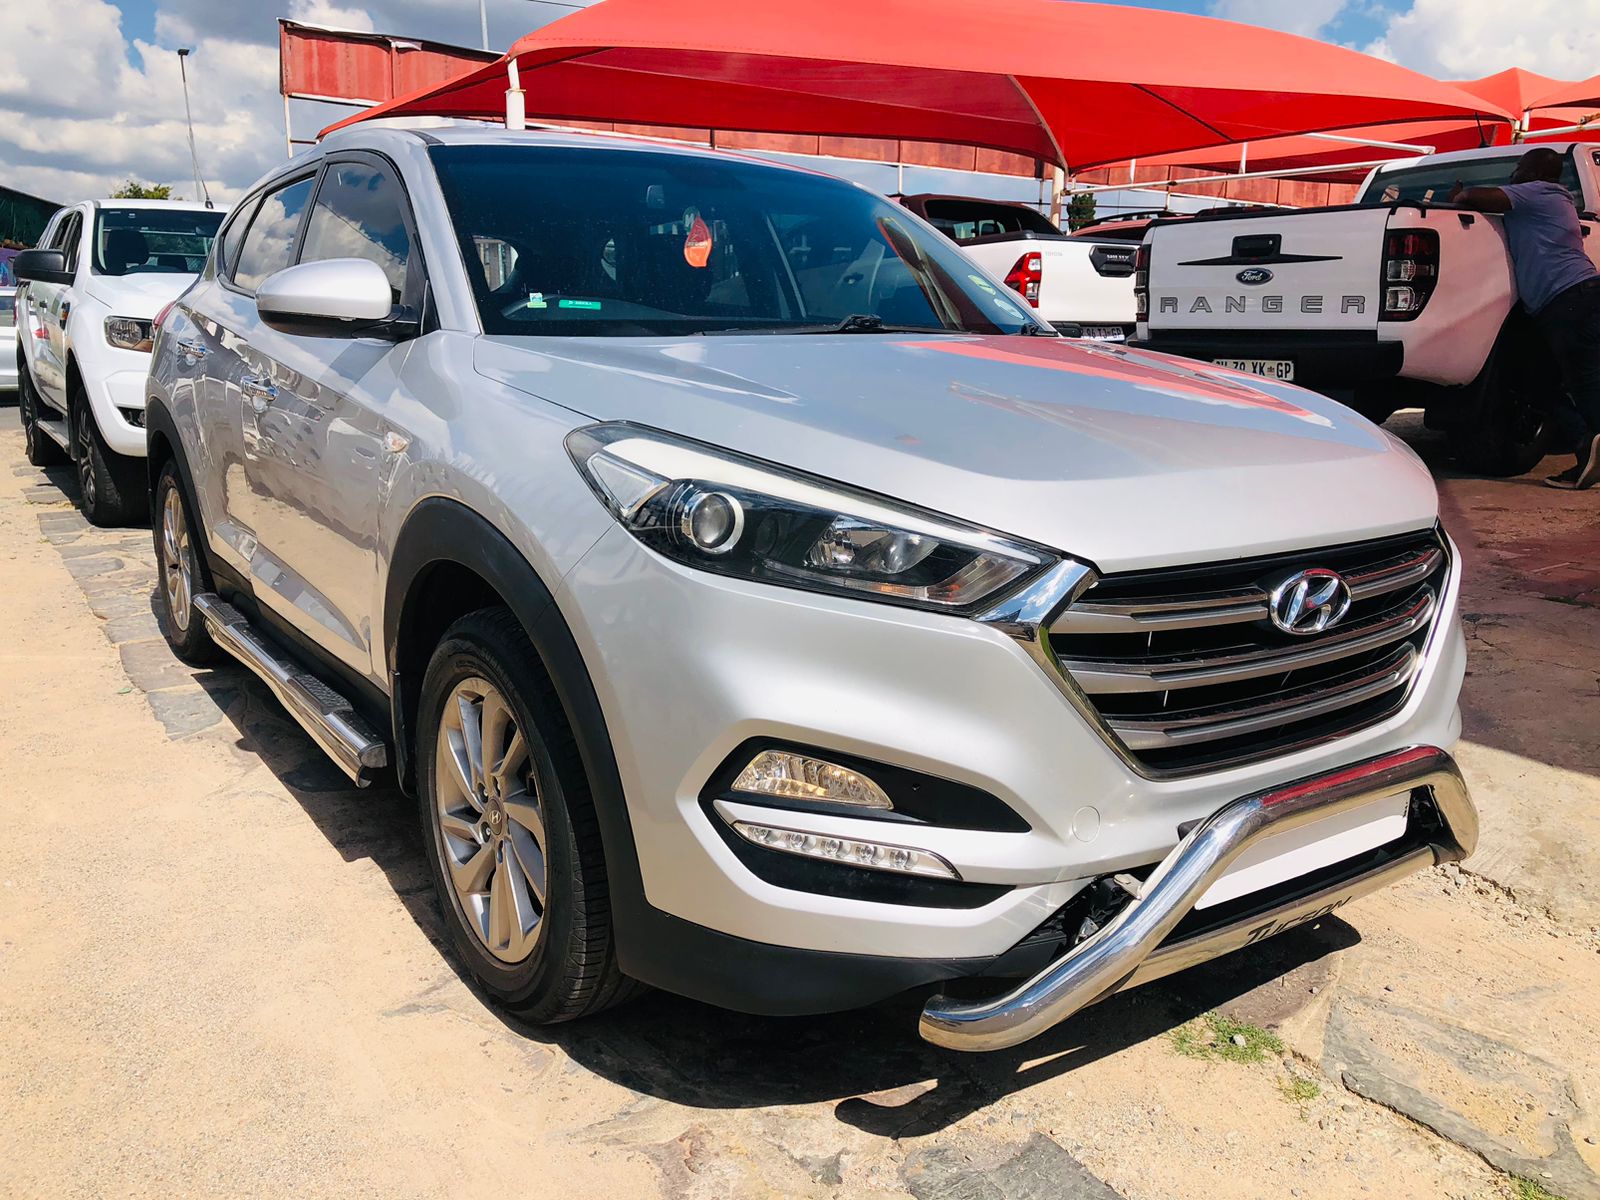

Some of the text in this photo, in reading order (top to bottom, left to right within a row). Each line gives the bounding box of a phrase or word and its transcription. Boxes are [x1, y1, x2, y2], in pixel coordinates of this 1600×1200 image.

[1241, 270, 1263, 281] Ford
[1160, 295, 1366, 313] RANGER
[1276, 362, 1291, 379] GP
